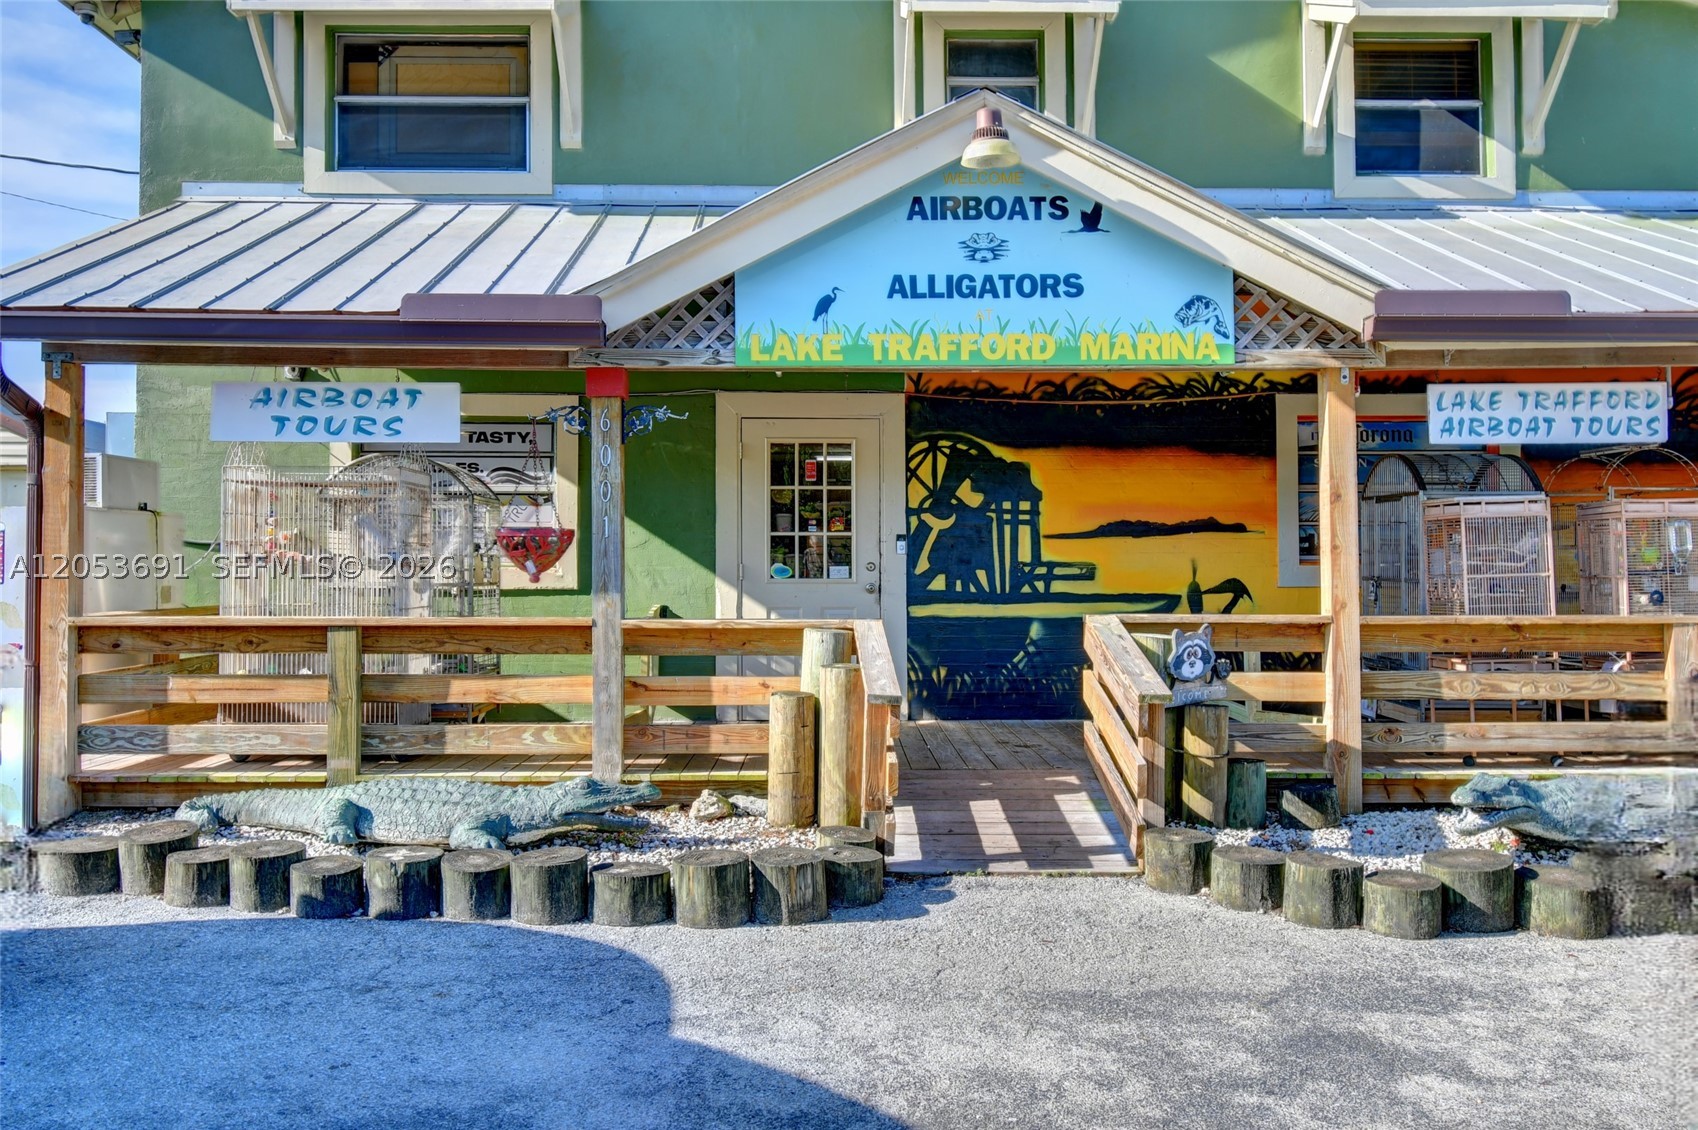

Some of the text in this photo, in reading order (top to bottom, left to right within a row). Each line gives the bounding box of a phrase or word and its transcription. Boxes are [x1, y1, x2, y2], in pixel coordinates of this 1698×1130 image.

[943, 170, 1025, 185] WELCOME
[906, 195, 1069, 221] AIRBOATS
[887, 273, 1084, 300] ALLIGATORS
[975, 308, 993, 321] AT
[750, 333, 1219, 362] LAKE TRAFFORD MARINA
[250, 387, 423, 410] AIRBOAT
[1436, 389, 1661, 412] LAKE TRAFFORD
[271, 415, 404, 437] TOURS
[1440, 414, 1661, 438] AIRBOAT TOURS
[600, 408, 611, 538] 6001
